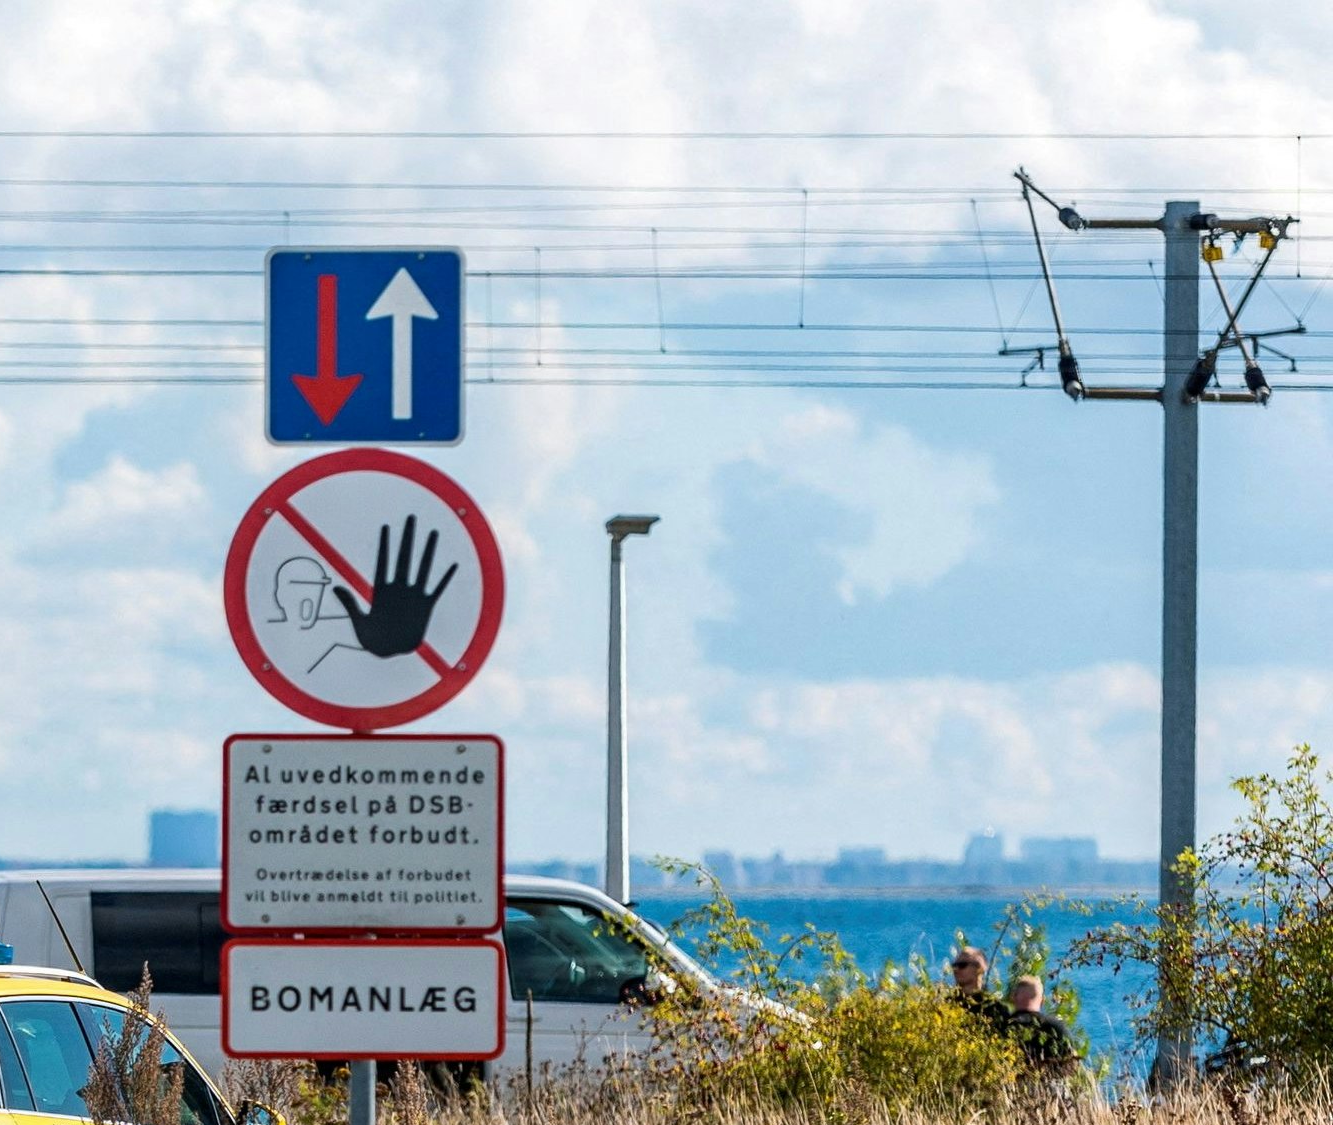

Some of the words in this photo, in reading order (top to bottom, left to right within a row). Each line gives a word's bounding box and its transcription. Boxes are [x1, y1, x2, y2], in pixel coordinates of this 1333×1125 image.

[244, 765, 271, 784] Al
[281, 766, 485, 785] uvedkommende
[256, 795, 359, 815] færdsel
[368, 796, 398, 817] på
[409, 796, 474, 815] DSB-
[249, 825, 359, 844] området
[369, 826, 480, 845] forbudt.
[256, 868, 370, 882] Overtrædelse
[376, 869, 392, 882] af
[398, 869, 471, 882] forbudet
[245, 890, 265, 903] vil
[271, 891, 311, 903] blive
[317, 891, 384, 903] anmeldt
[390, 891, 409, 904] til
[414, 891, 483, 906] politiet.
[250, 985, 478, 1013] BOMANLÆG
